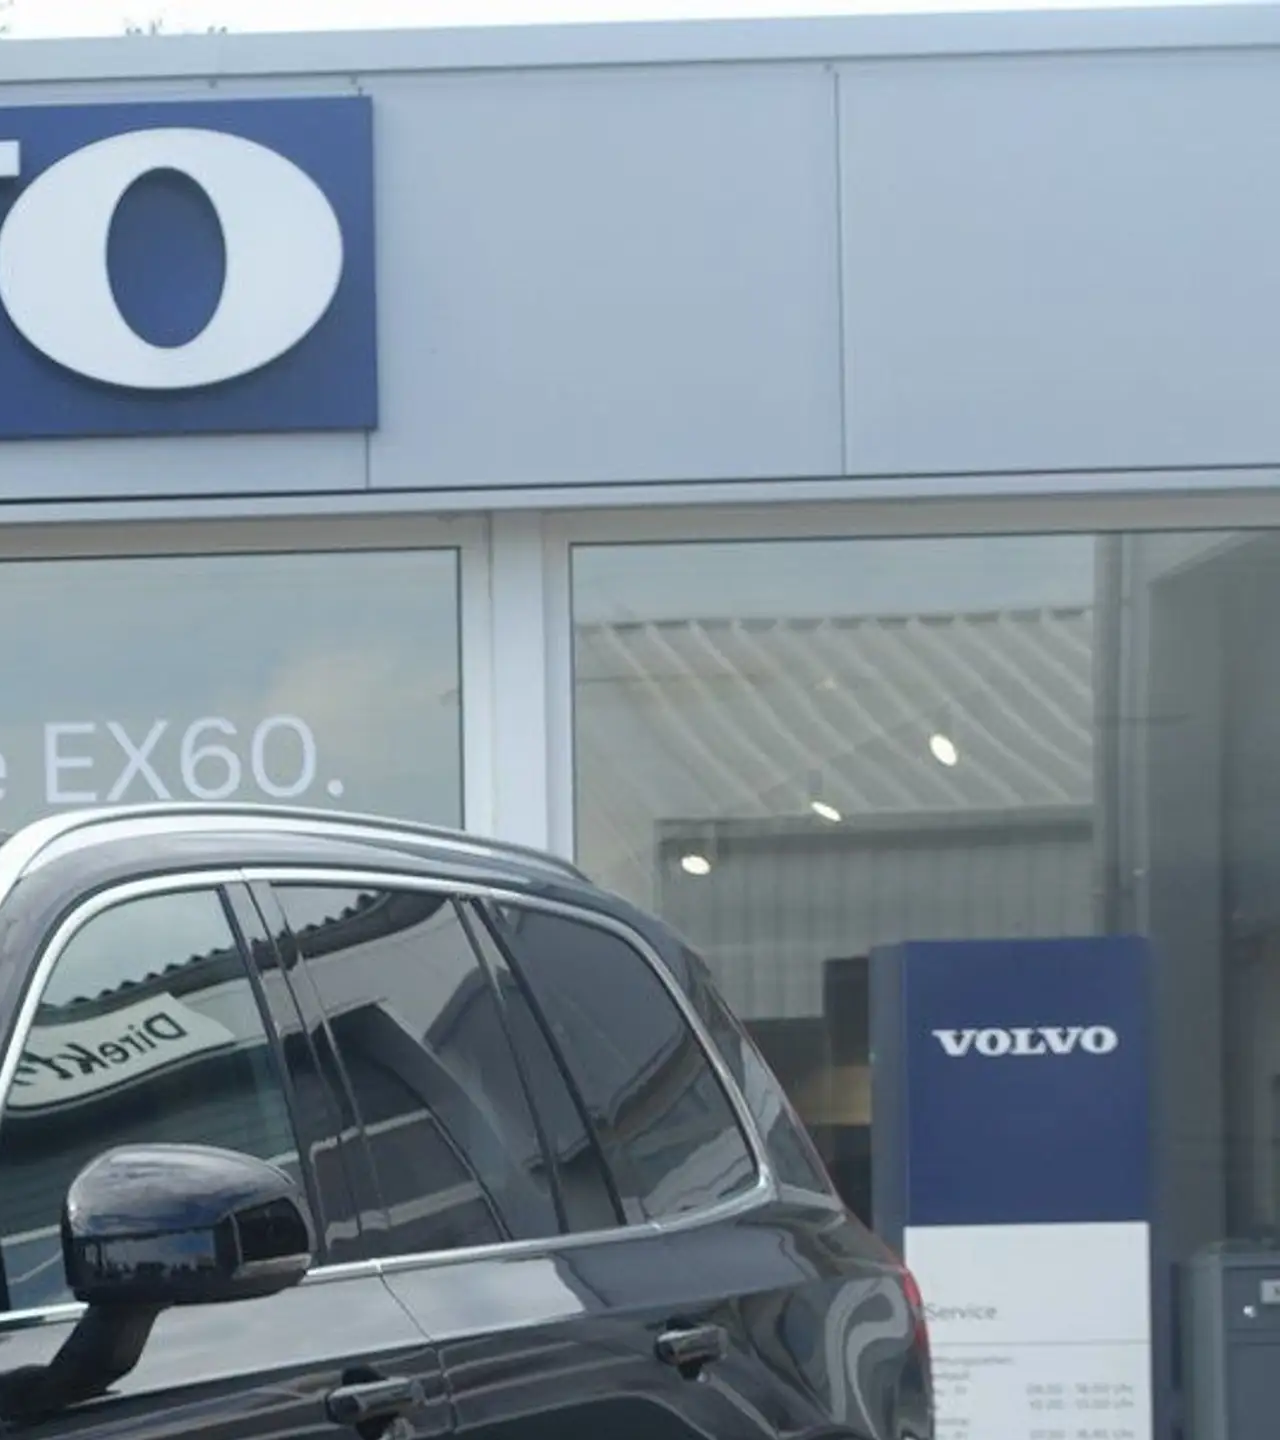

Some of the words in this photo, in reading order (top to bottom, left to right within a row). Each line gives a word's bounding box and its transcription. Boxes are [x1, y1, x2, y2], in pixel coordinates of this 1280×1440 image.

[43, 713, 345, 804] EX60.
[932, 1025, 1119, 1057] VOLVO
[925, 1303, 997, 1321] Service
